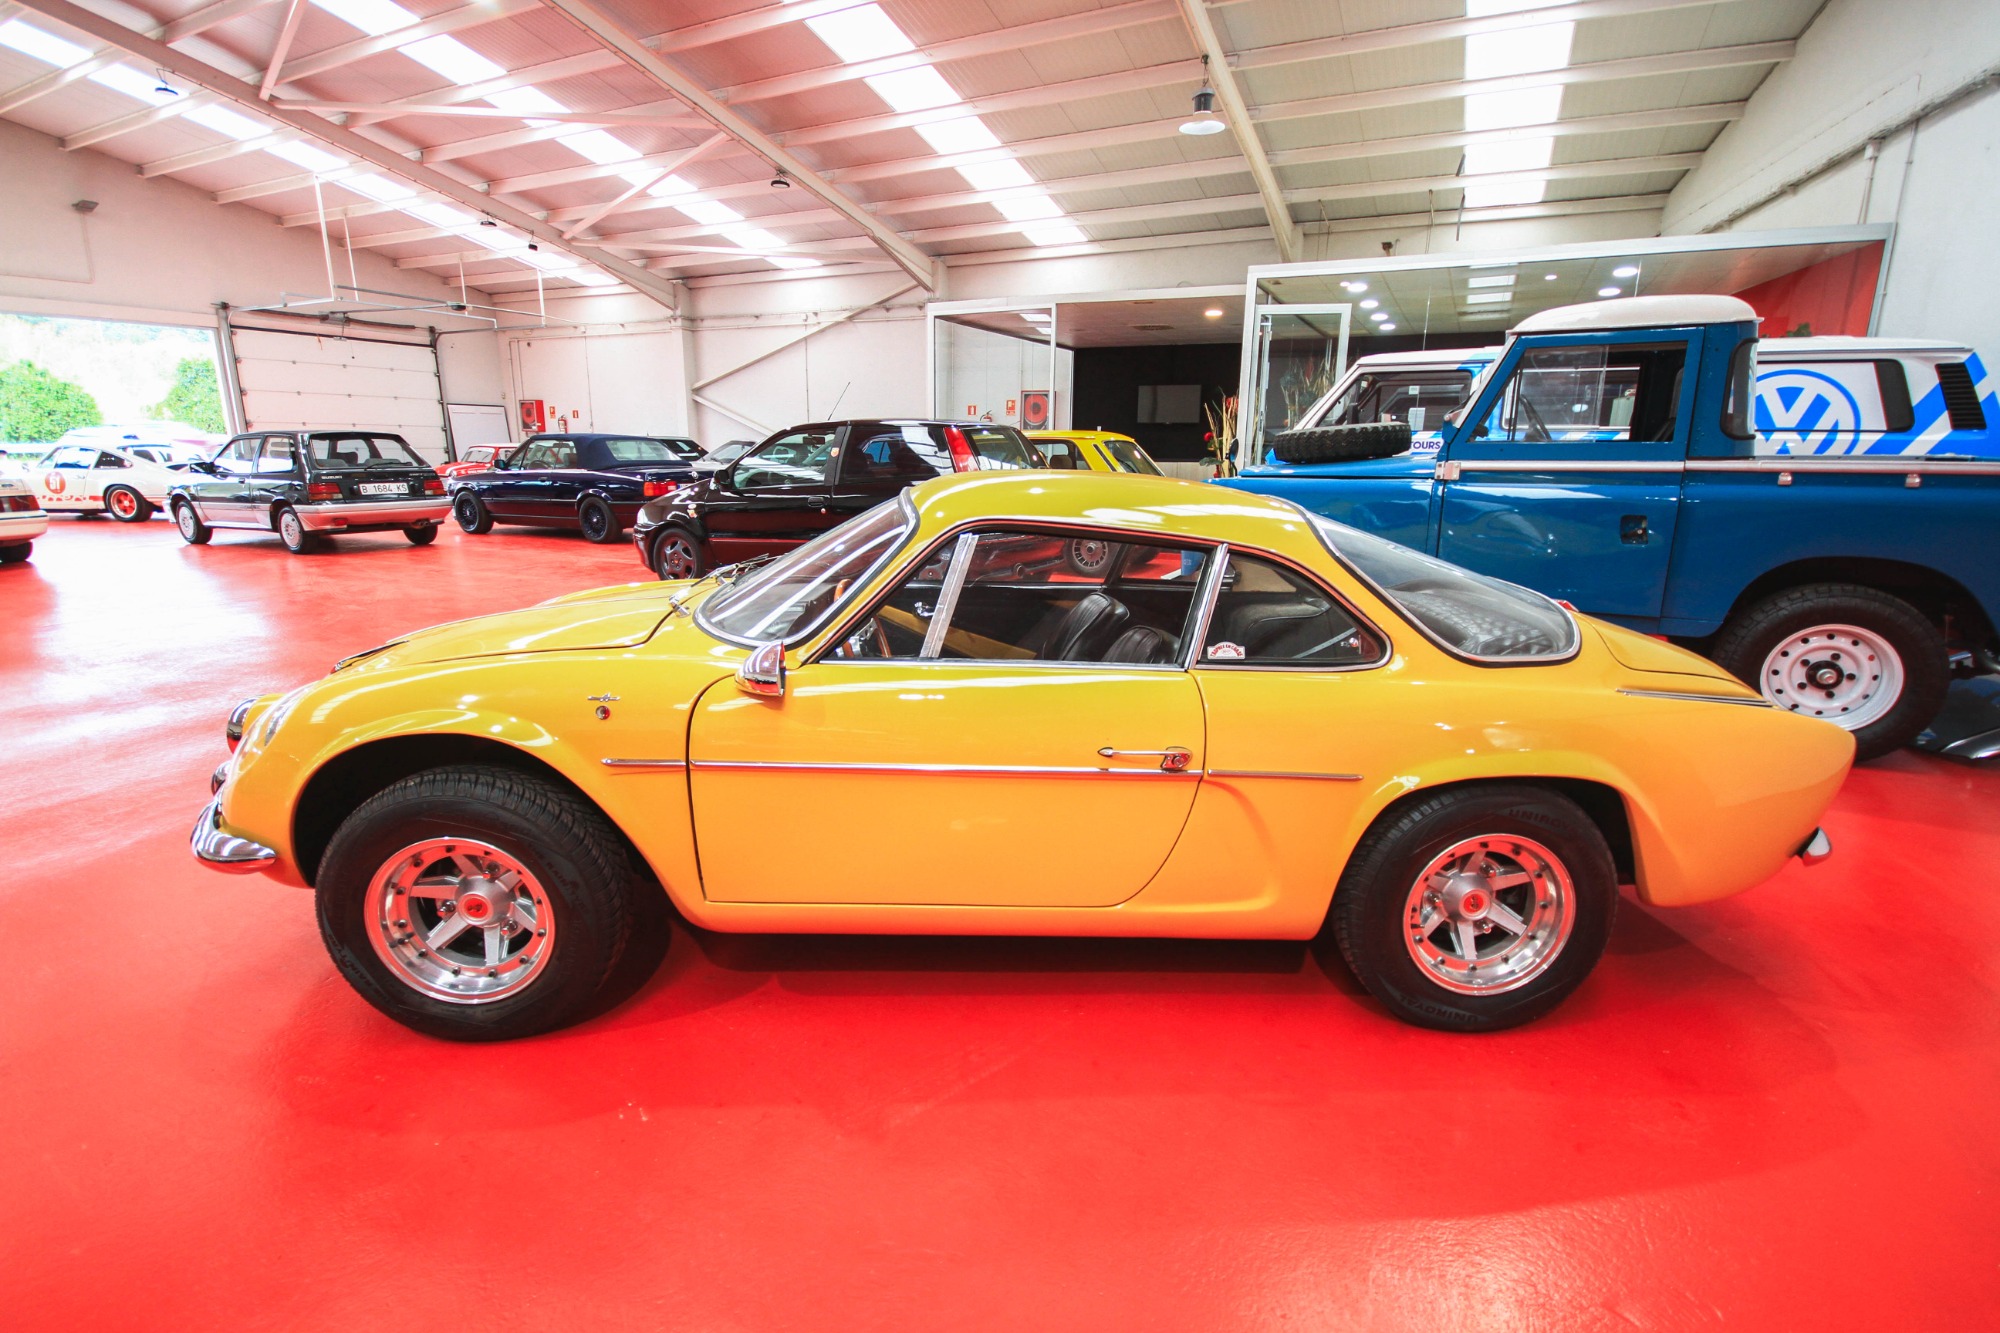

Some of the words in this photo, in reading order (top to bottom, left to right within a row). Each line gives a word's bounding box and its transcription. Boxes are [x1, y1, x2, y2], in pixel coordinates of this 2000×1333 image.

[362, 485, 368, 493] B
[373, 484, 393, 492] 1684
[397, 484, 408, 492] KS
[1400, 994, 1479, 1023] UNIROYAL
